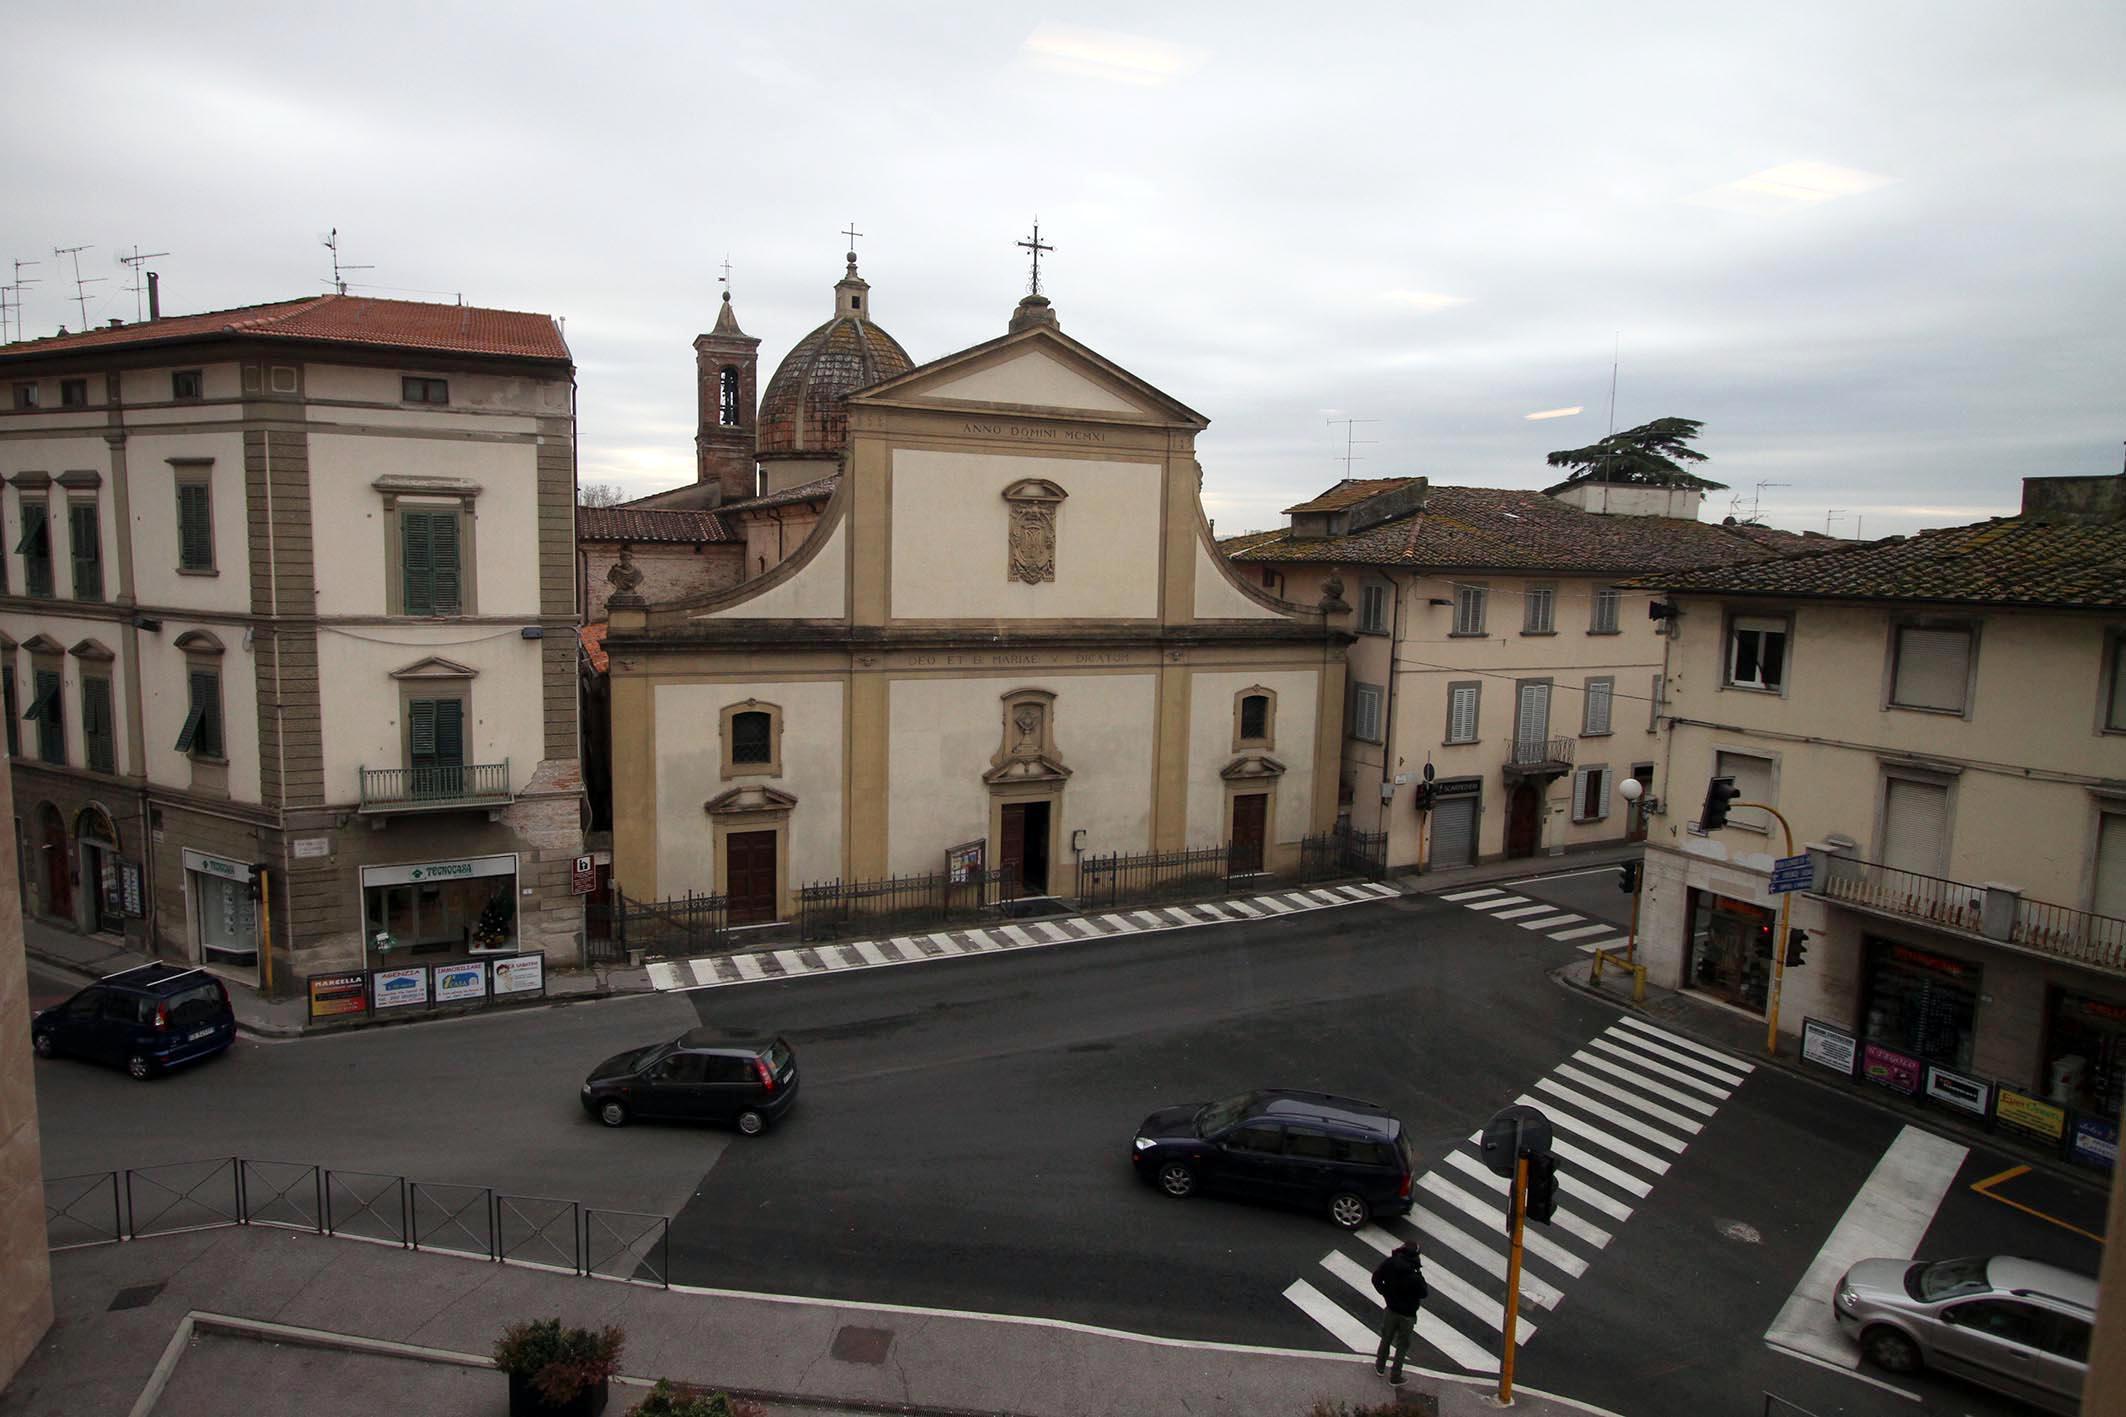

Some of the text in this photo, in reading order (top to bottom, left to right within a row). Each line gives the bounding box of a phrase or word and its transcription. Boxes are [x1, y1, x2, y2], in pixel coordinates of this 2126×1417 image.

[963, 423, 1001, 435] ANNO
[1010, 425, 1057, 439] DOMINI
[908, 656, 936, 666] DEO
[946, 655, 963, 665] ET
[426, 863, 473, 877] TECNOCASA
[382, 969, 420, 978] AGENZIA
[315, 976, 363, 987] MARCELLA
